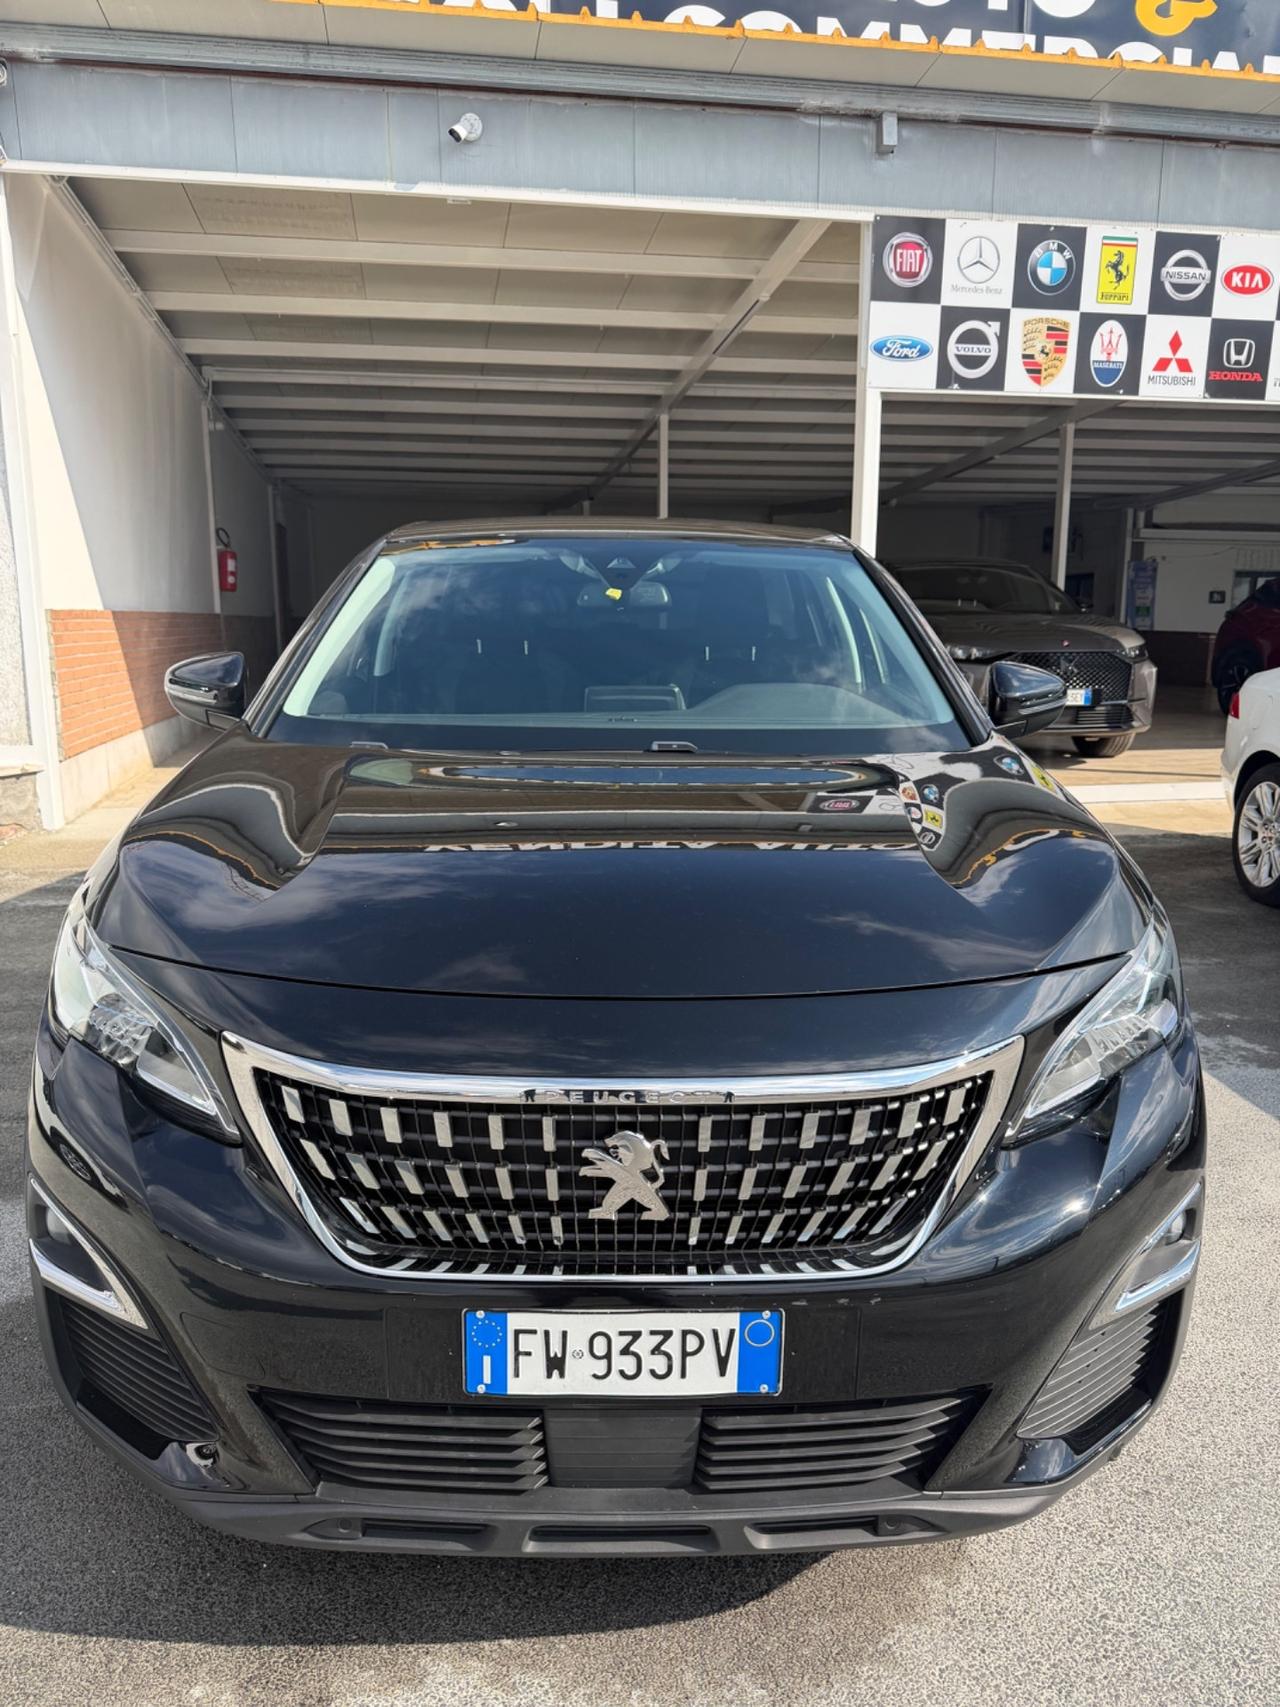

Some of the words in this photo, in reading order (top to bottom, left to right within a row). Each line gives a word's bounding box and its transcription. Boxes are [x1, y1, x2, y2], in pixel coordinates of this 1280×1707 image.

[1034, 241, 1072, 260] BMW
[896, 249, 921, 273] FIAT
[1165, 271, 1206, 281] NISSAN
[1231, 272, 1264, 289] KIA
[950, 283, 985, 294] Mercedes
[1099, 291, 1130, 302] Ferrari
[1023, 317, 1071, 330] PORSCHE
[882, 339, 920, 358] Ford
[955, 345, 992, 354] VOLVO
[1093, 361, 1124, 369] MASERATI
[1147, 375, 1196, 387] MITSUBISHI
[1208, 370, 1264, 382] HONDA
[513, 1328, 568, 1379] FW
